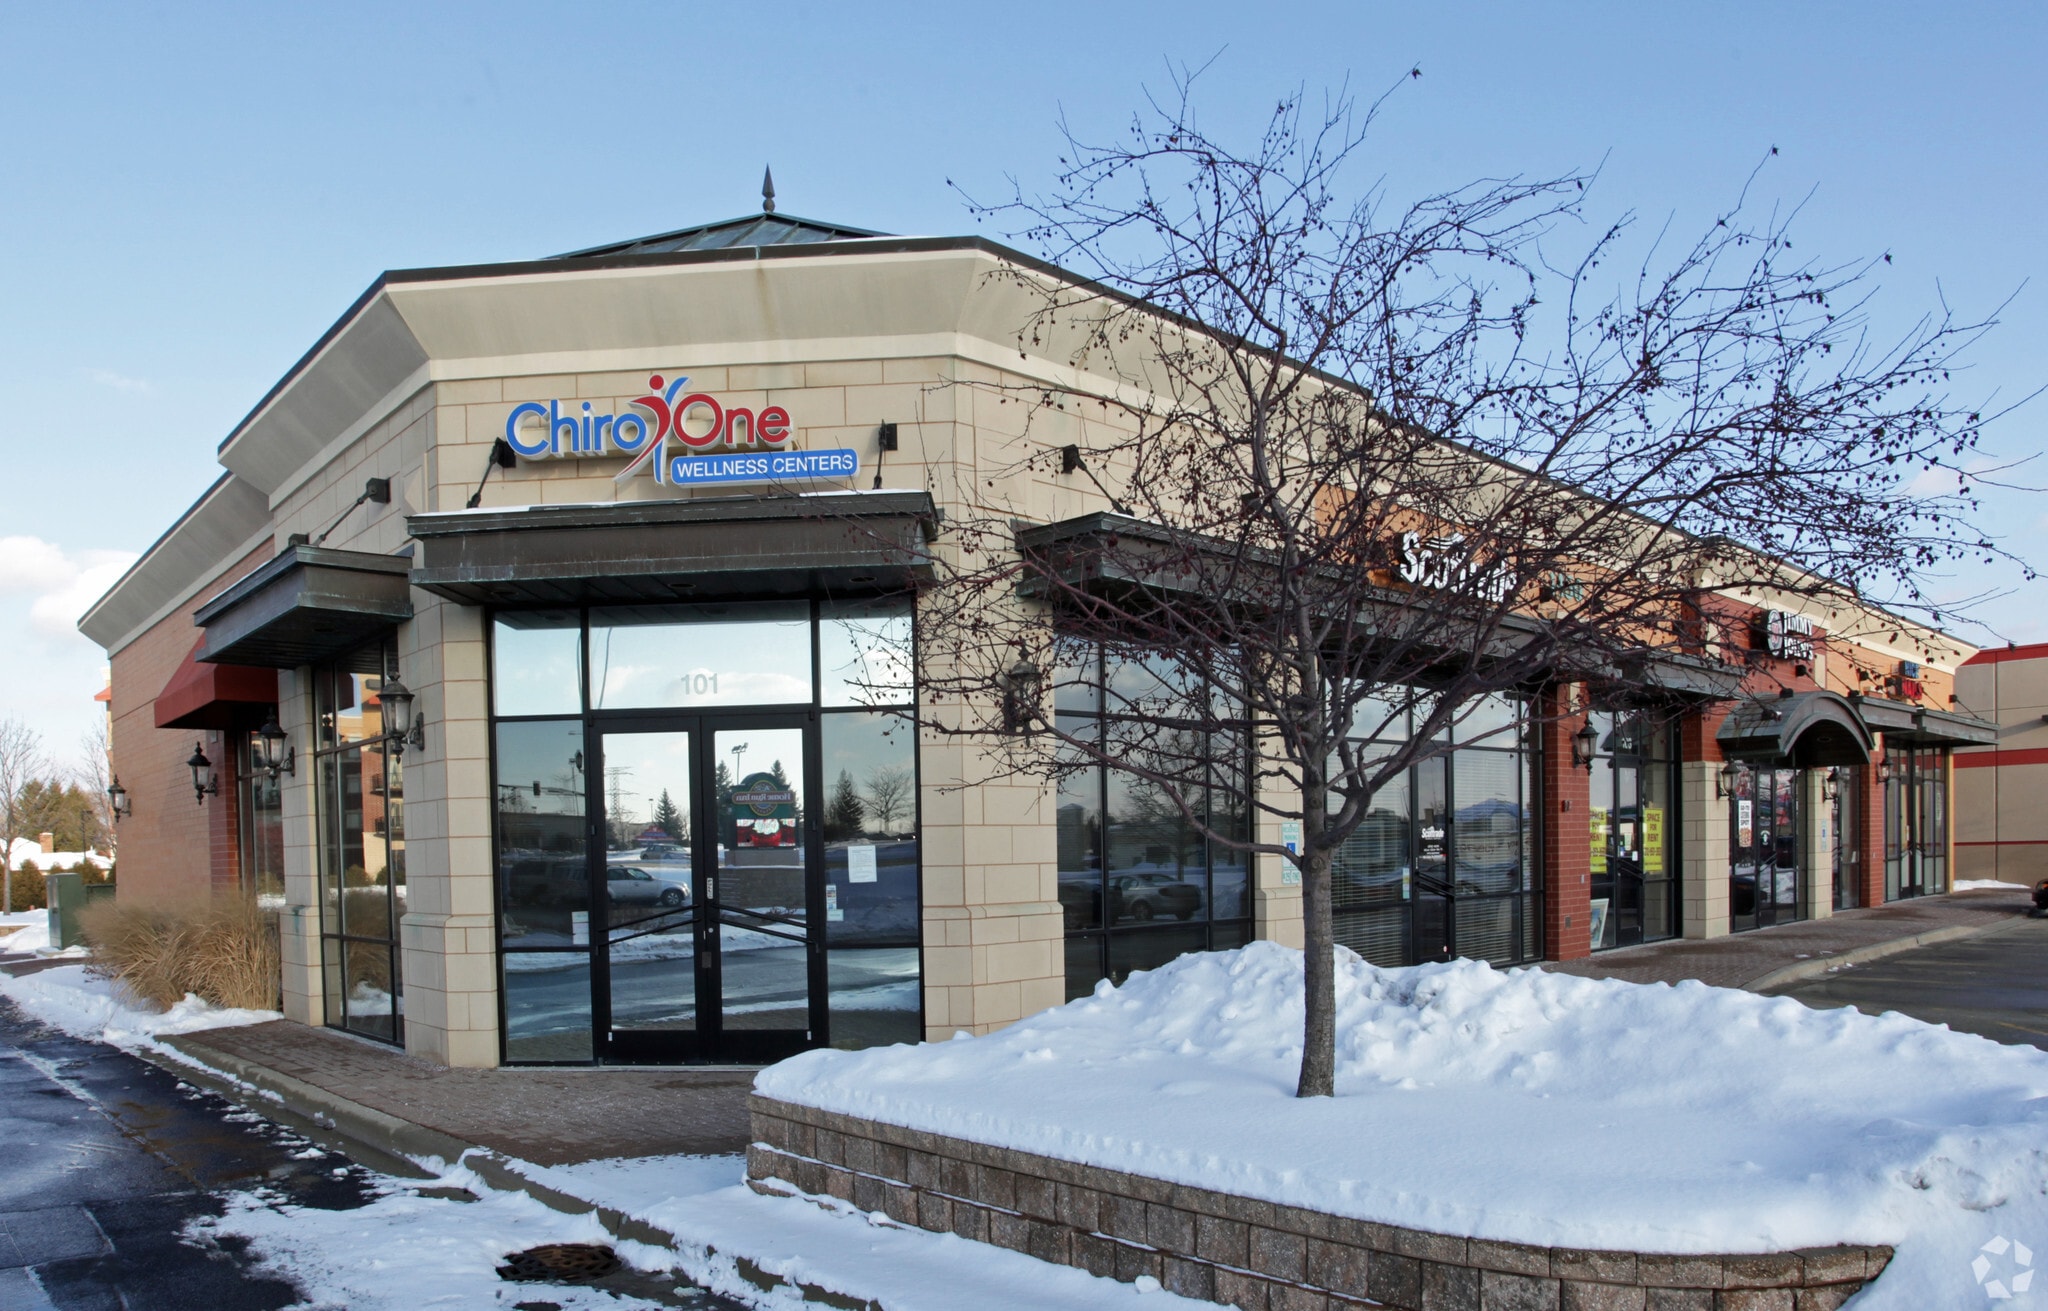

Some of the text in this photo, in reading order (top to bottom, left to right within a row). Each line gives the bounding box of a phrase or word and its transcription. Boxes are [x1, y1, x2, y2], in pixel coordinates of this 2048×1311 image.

[505, 393, 792, 457] Chiro One
[676, 454, 854, 478] WELLNESS CENTERS
[1783, 611, 1813, 636] JIMMY
[680, 673, 718, 695] 101
[1647, 813, 1660, 822] SPACE
[1648, 834, 1659, 842] RENT
